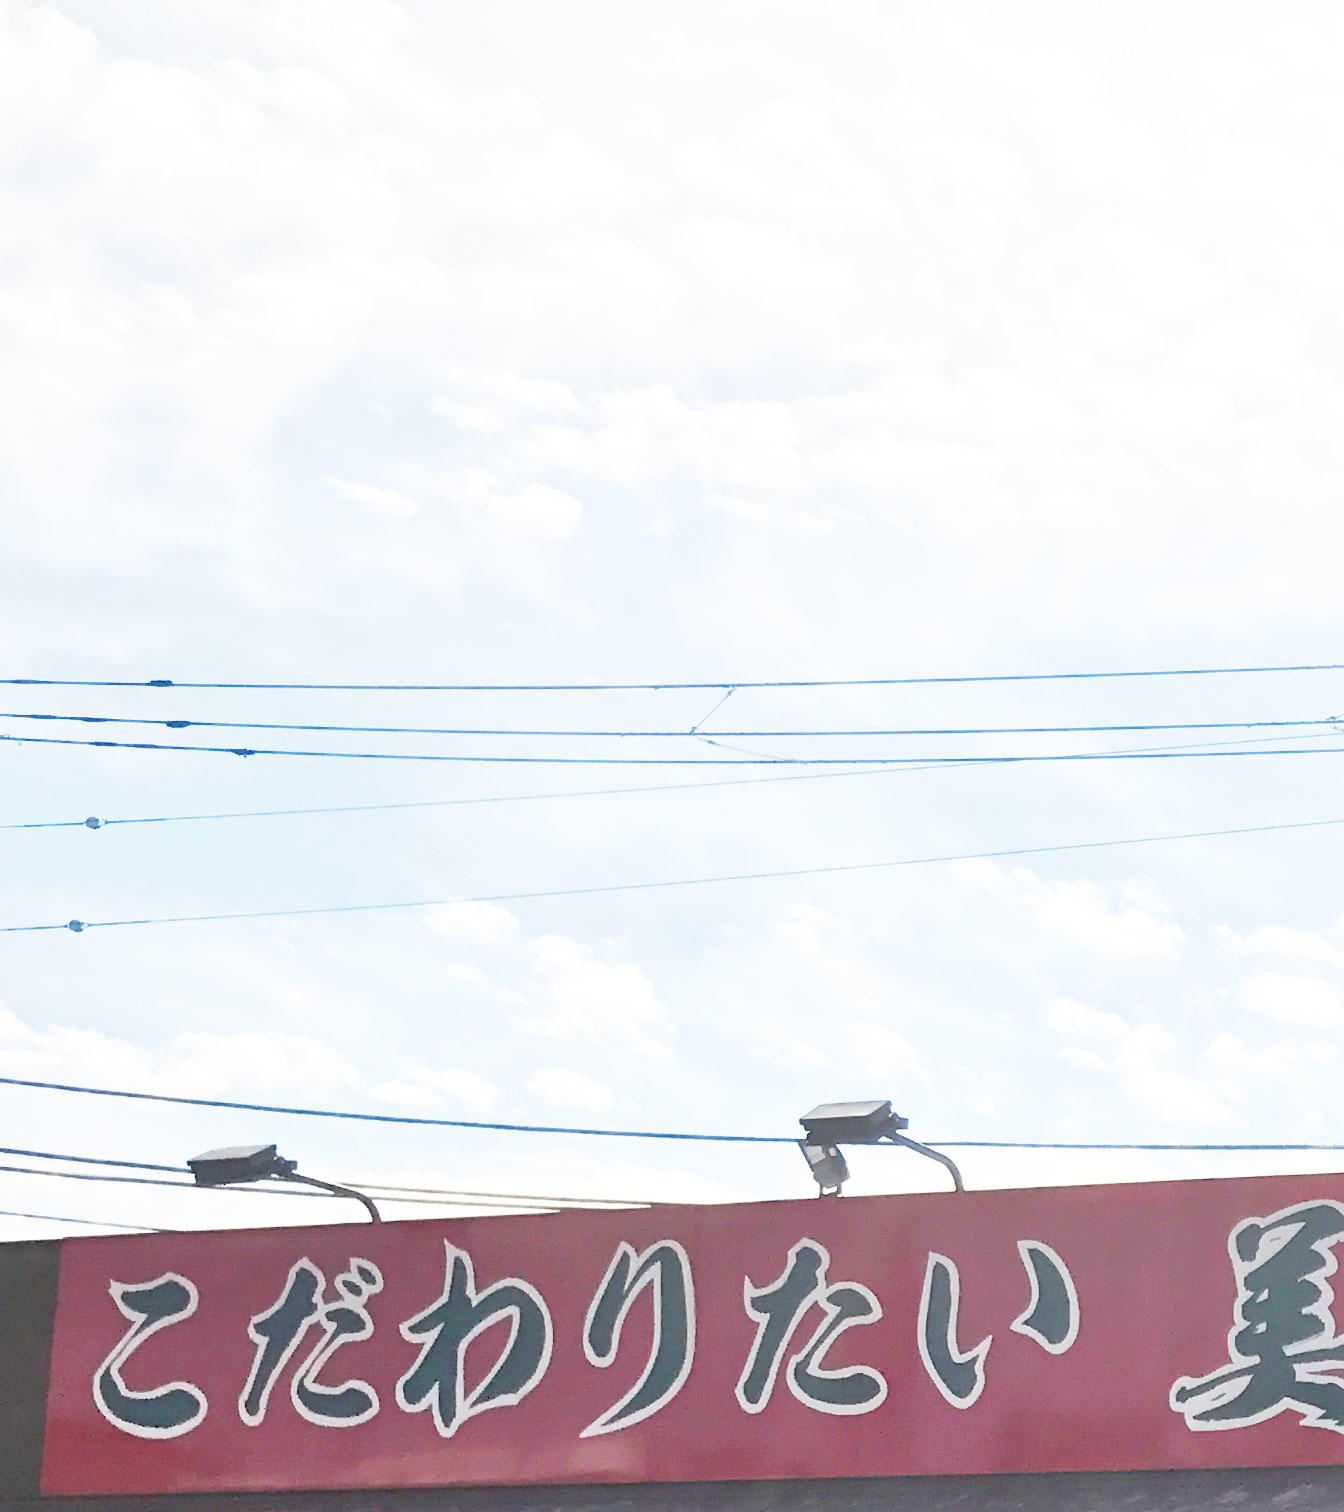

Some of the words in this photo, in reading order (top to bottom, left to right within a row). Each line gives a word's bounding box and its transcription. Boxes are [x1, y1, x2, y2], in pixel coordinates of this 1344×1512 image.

[92, 1236, 1081, 1441] こだわりたい
